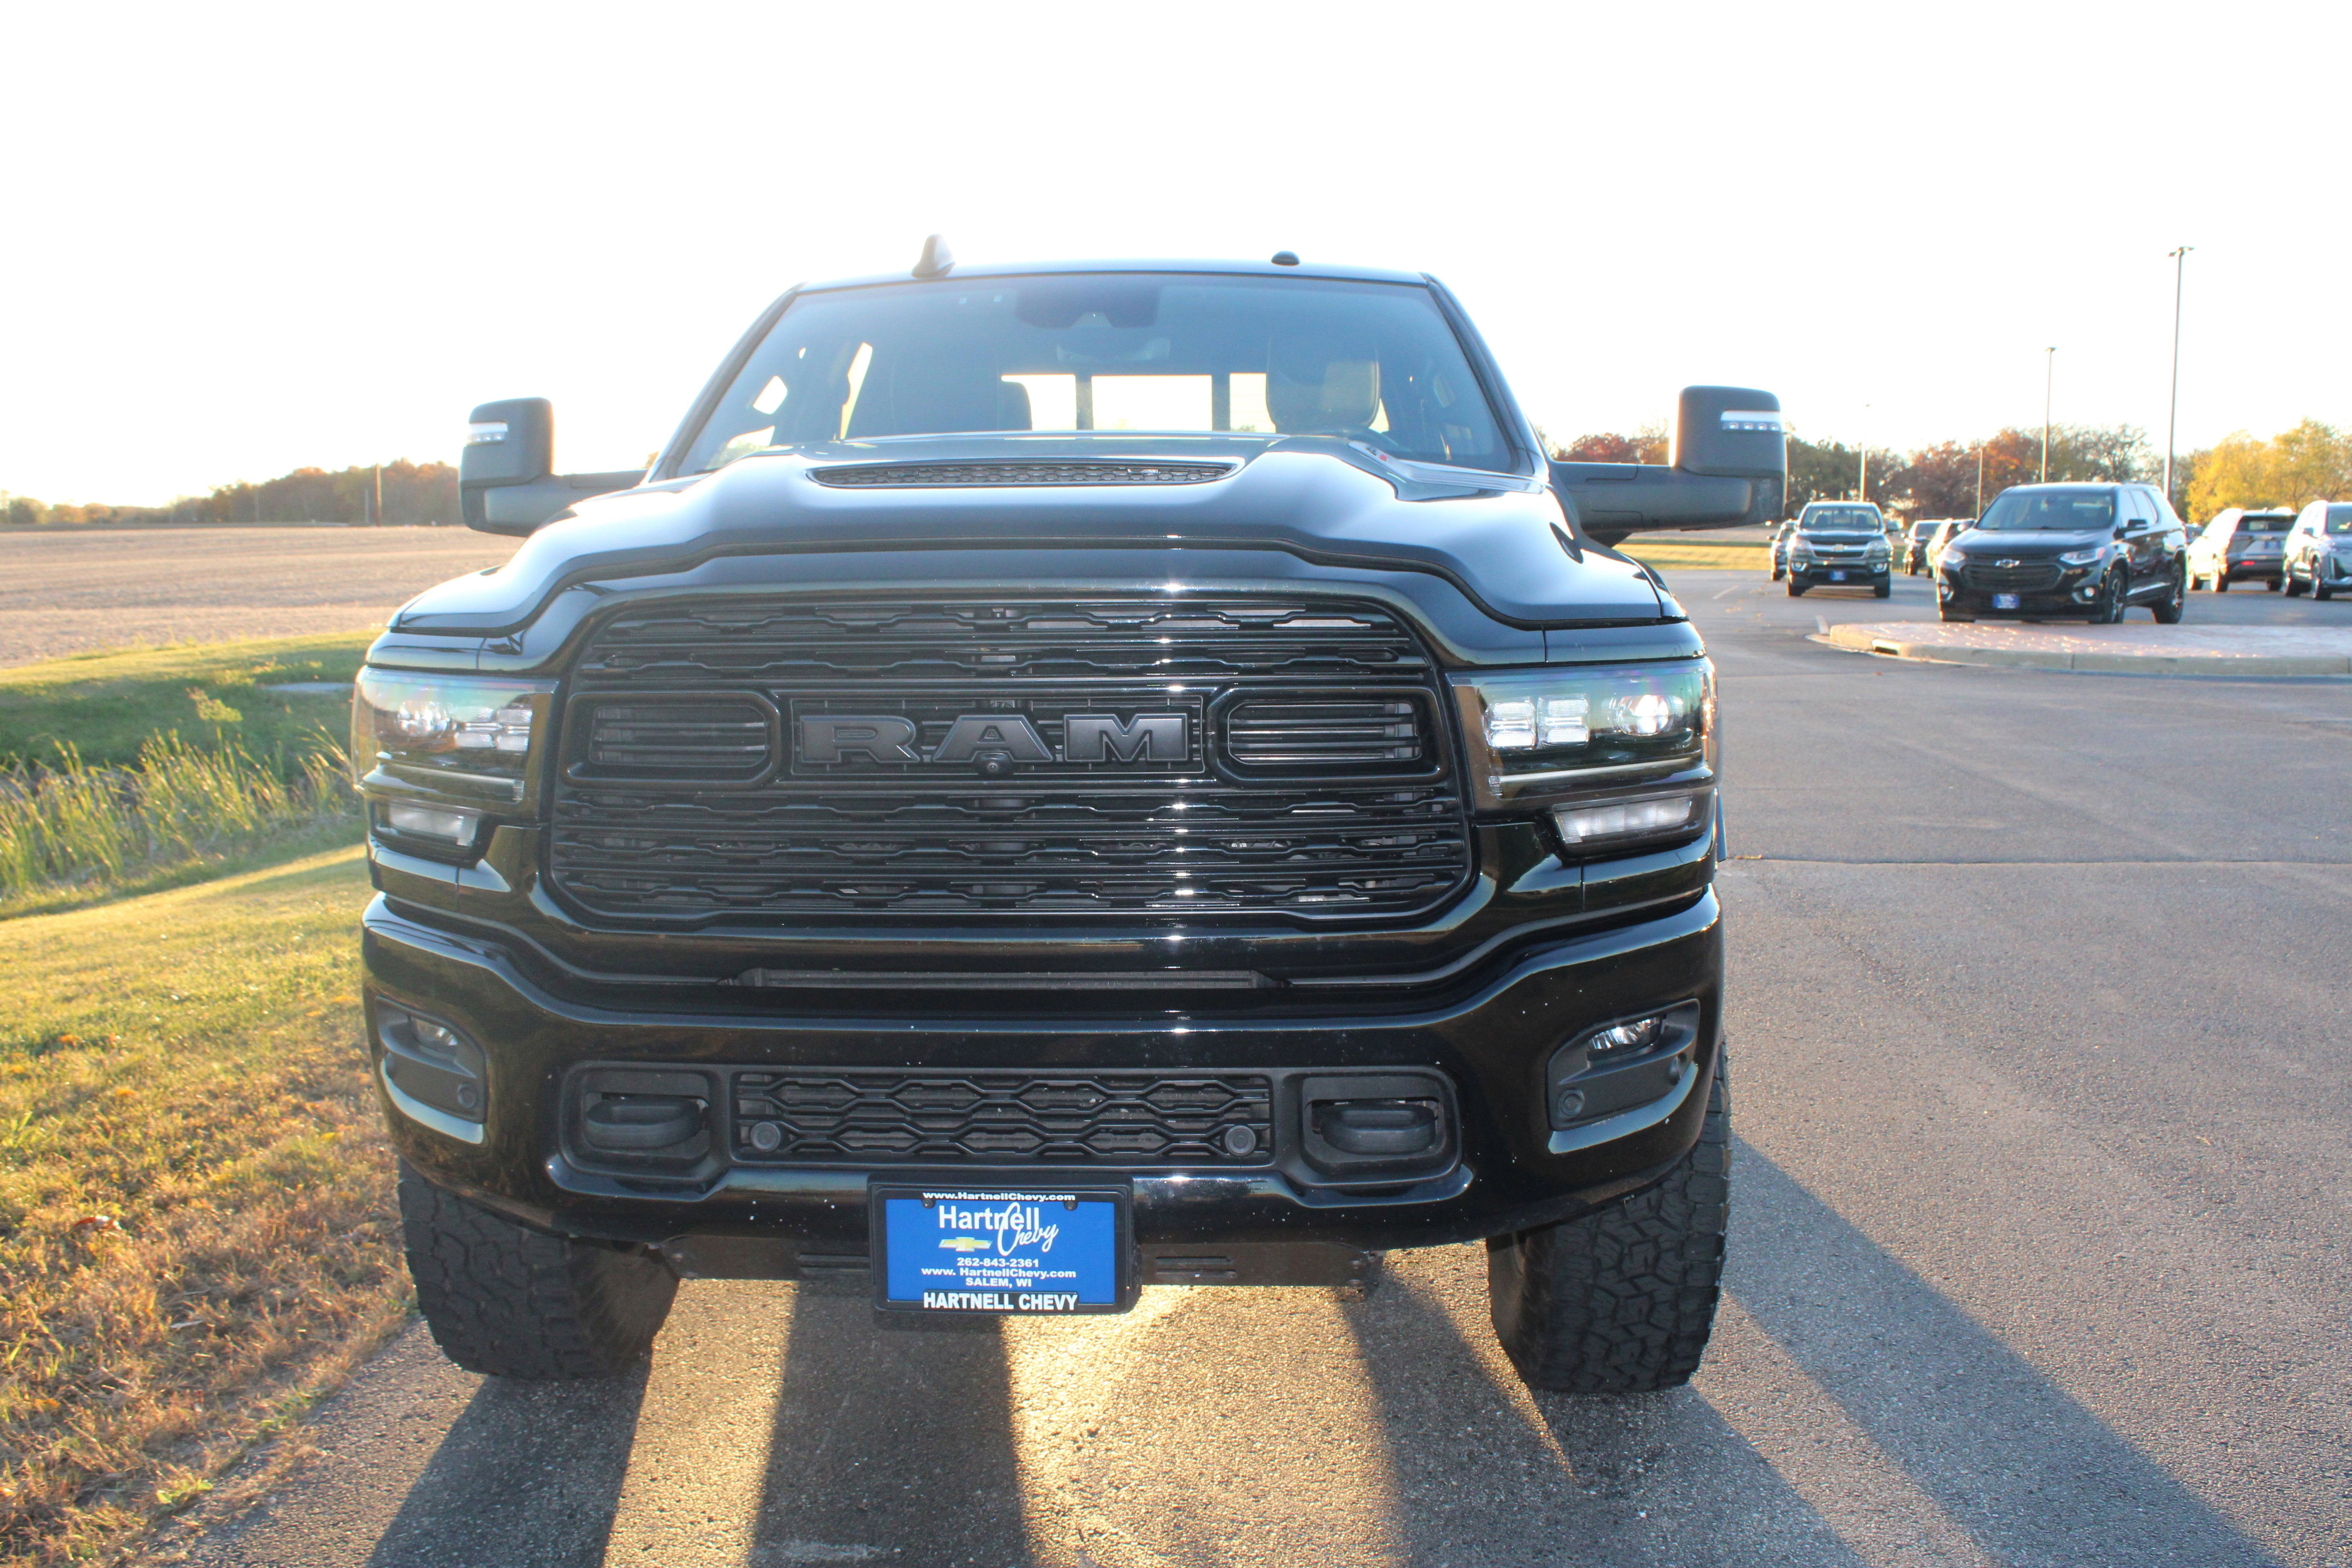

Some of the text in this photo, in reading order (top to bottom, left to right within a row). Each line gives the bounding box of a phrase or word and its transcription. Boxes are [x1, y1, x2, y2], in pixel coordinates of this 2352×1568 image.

[800, 713, 1188, 762] RAM
[923, 1192, 1076, 1202] www.HartnellChevy.com
[939, 1205, 1039, 1230] Hartnell
[998, 1202, 1059, 1256] Chevy
[957, 1257, 1039, 1267] 262-843-2361
[966, 1277, 1031, 1288] SALEM, WI
[924, 1292, 1078, 1310] HARTNELL CHEVY
